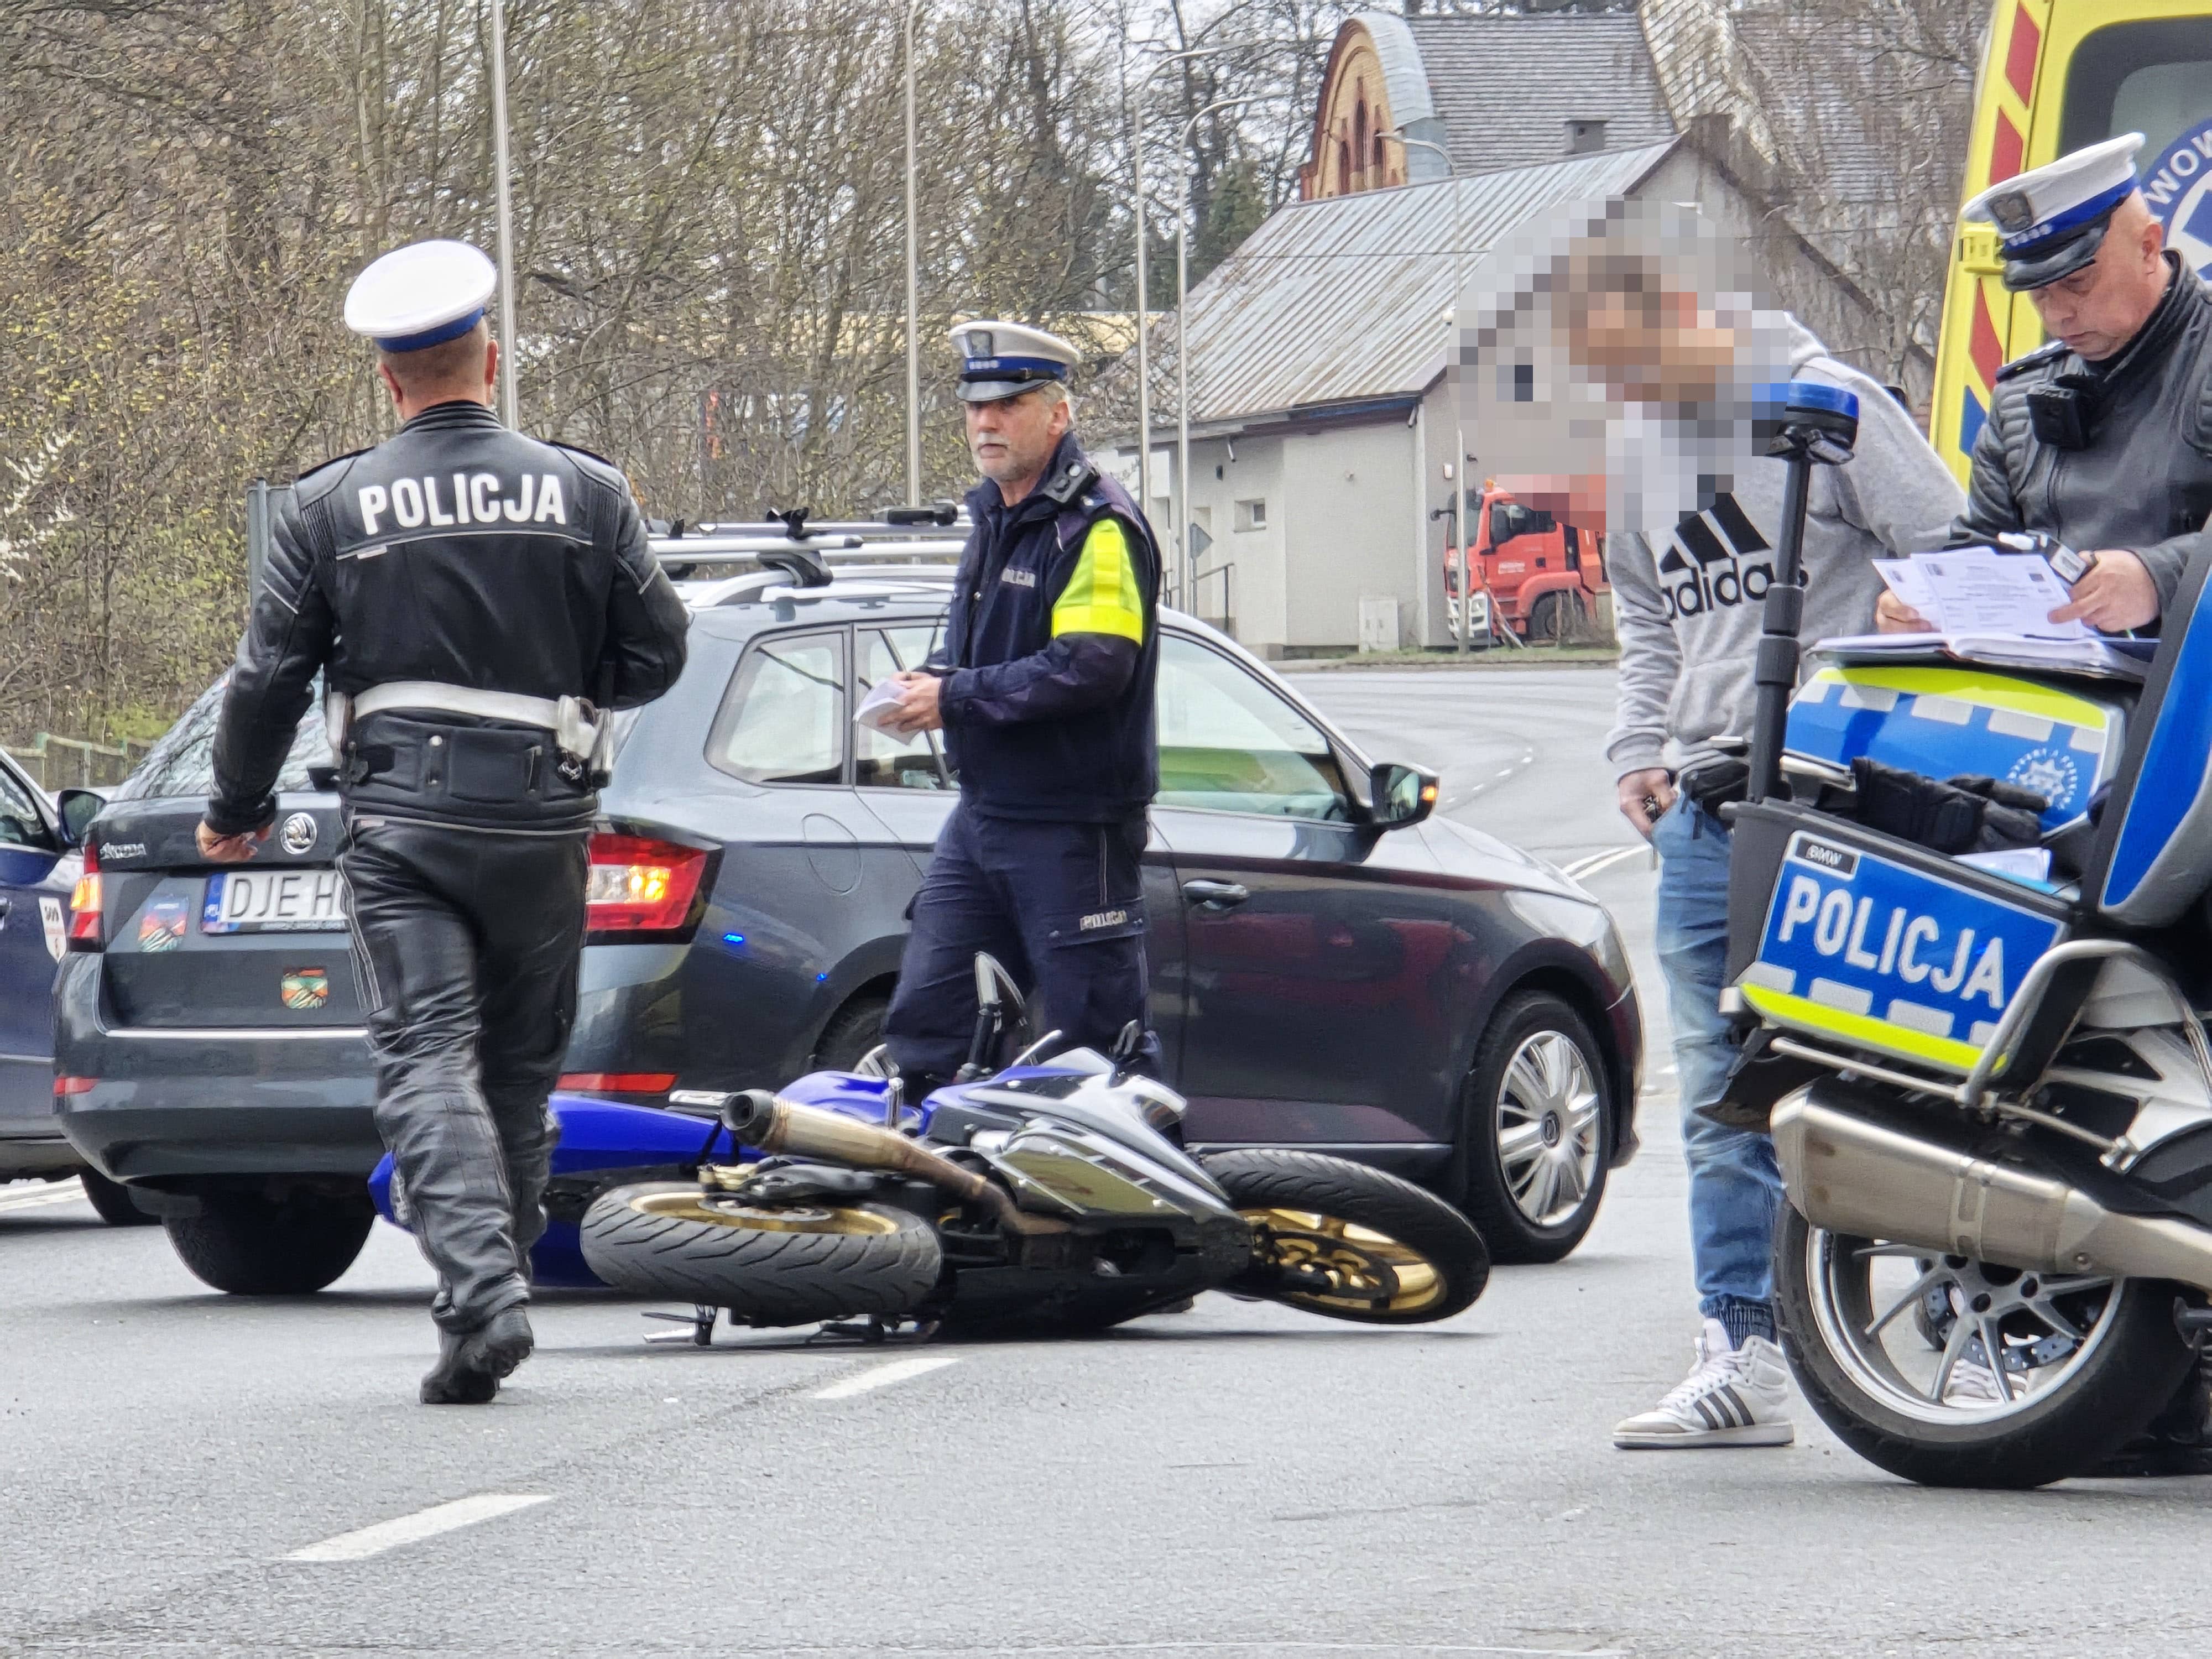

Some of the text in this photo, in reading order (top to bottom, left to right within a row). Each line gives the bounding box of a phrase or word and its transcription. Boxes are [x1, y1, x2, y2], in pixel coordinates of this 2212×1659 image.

[358, 473, 566, 536] POLICJA
[1806, 844, 1842, 867] BMW
[1778, 875, 2004, 1009] POLICJA
